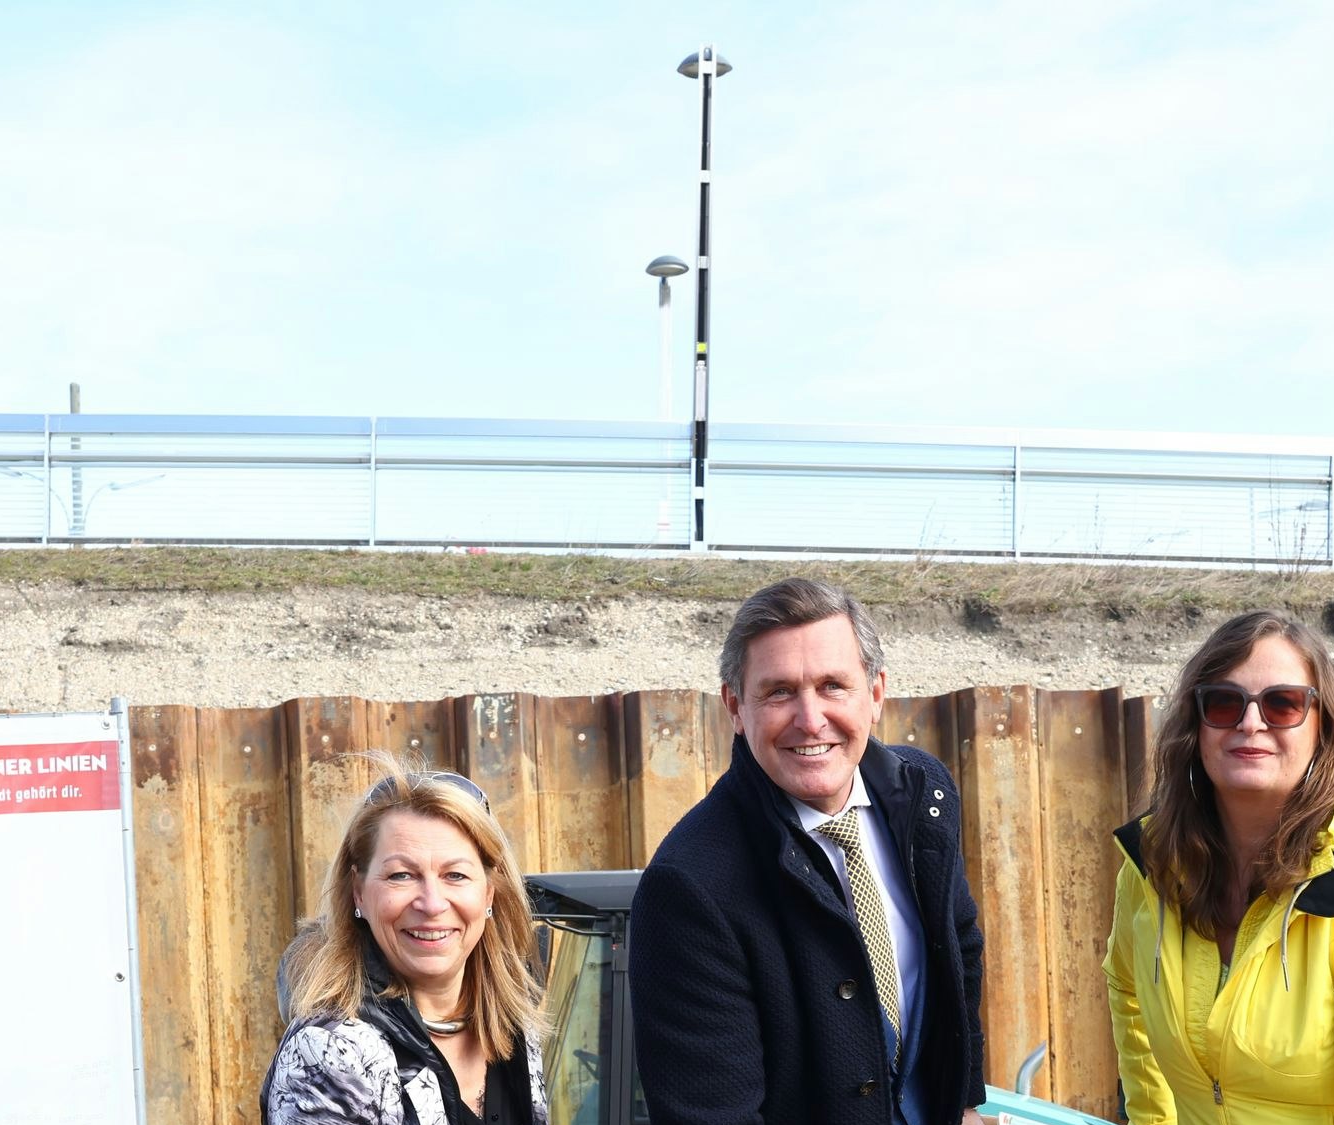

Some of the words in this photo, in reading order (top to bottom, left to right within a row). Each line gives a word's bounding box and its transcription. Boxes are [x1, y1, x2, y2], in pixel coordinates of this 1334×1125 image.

[37, 754, 107, 774] LINIEN
[15, 785, 58, 803] gehört
[61, 783, 83, 799] dir.
